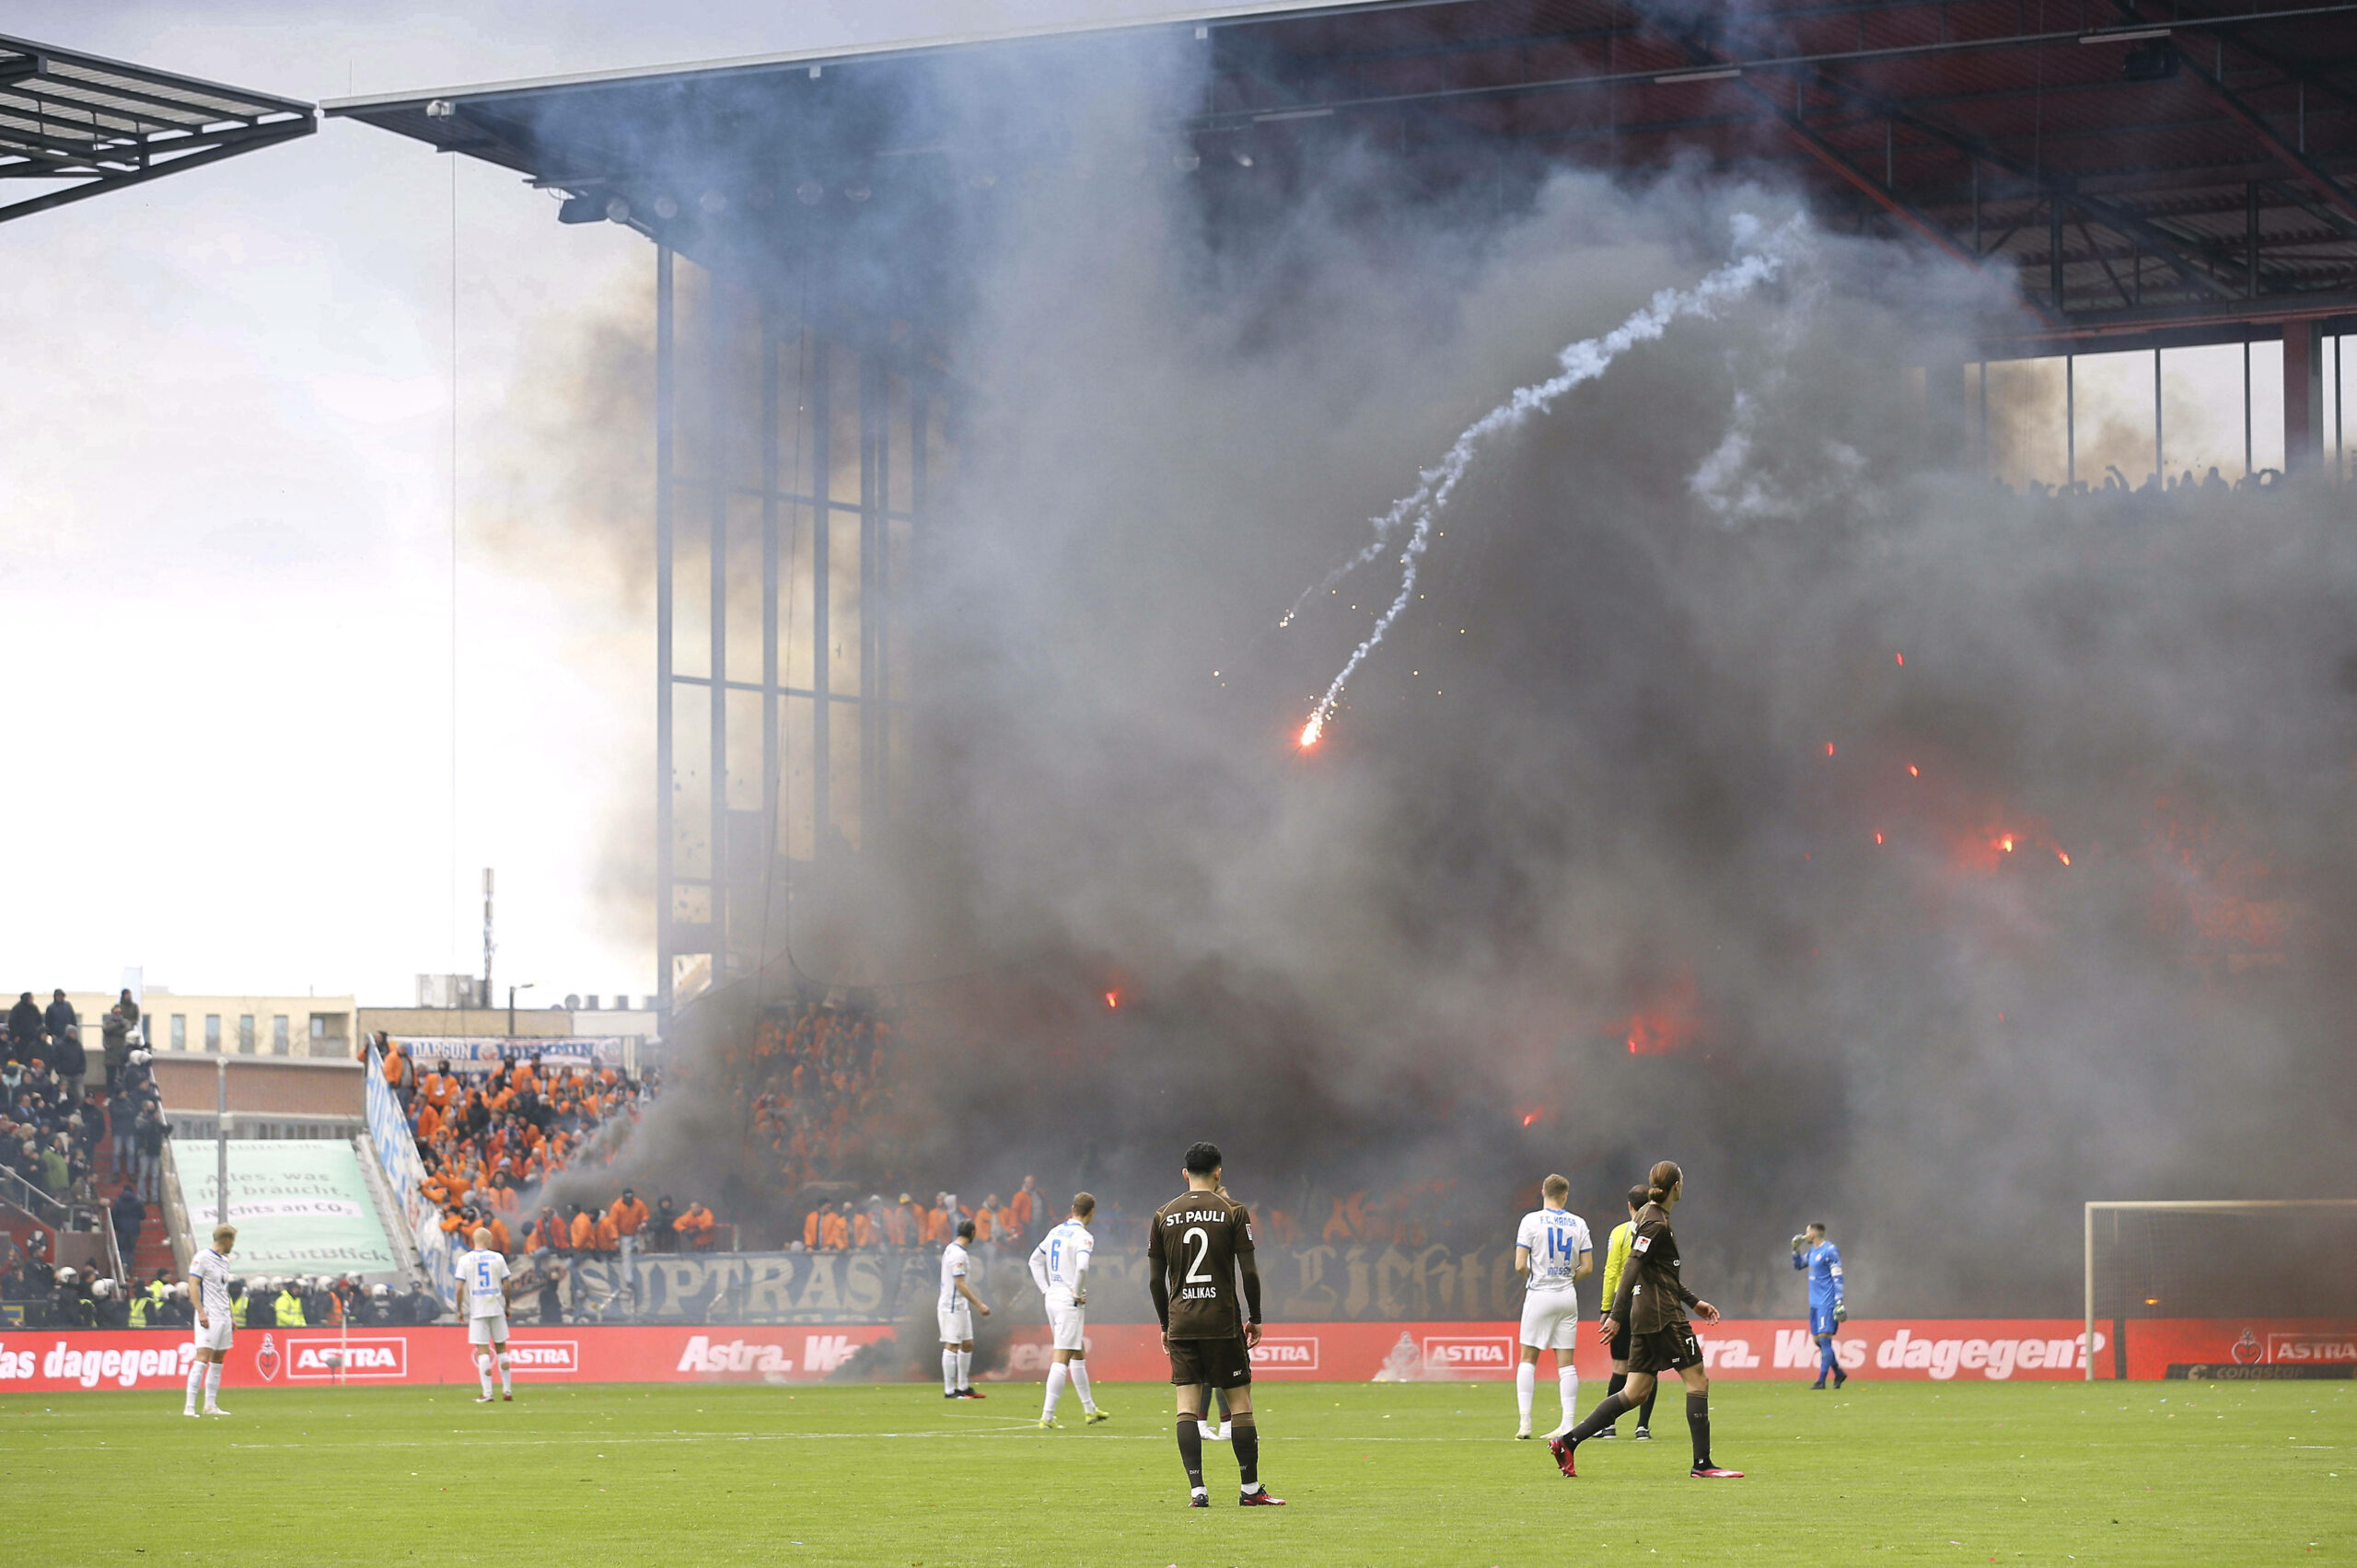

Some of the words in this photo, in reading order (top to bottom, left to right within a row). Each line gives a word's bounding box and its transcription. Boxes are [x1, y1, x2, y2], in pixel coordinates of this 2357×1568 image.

[412, 1041, 472, 1060] DARGUN
[205, 1172, 273, 1185] Ales,
[282, 1171, 330, 1181] was
[242, 1184, 352, 1197] braucht.
[203, 1204, 275, 1219] Nchts
[282, 1202, 308, 1213] an
[1166, 1213, 1184, 1227] ST.
[1185, 1210, 1225, 1224] PAULI
[250, 1247, 390, 1262] LichtBlick
[1548, 1226, 1573, 1264] 14
[1051, 1238, 1062, 1272] 6
[1183, 1227, 1213, 1284] 2
[478, 1262, 491, 1287] 5
[1182, 1287, 1216, 1300] SALIKAS
[676, 1335, 793, 1372] Astra.
[1432, 1345, 1504, 1362] ASTRA
[1686, 1336, 1695, 1356] 7
[1876, 1329, 2106, 1380] dagegen?
[0, 1342, 36, 1379] as
[43, 1341, 197, 1388] dagegen?
[296, 1347, 397, 1369] ASTRA
[507, 1348, 571, 1364] ASTRA
